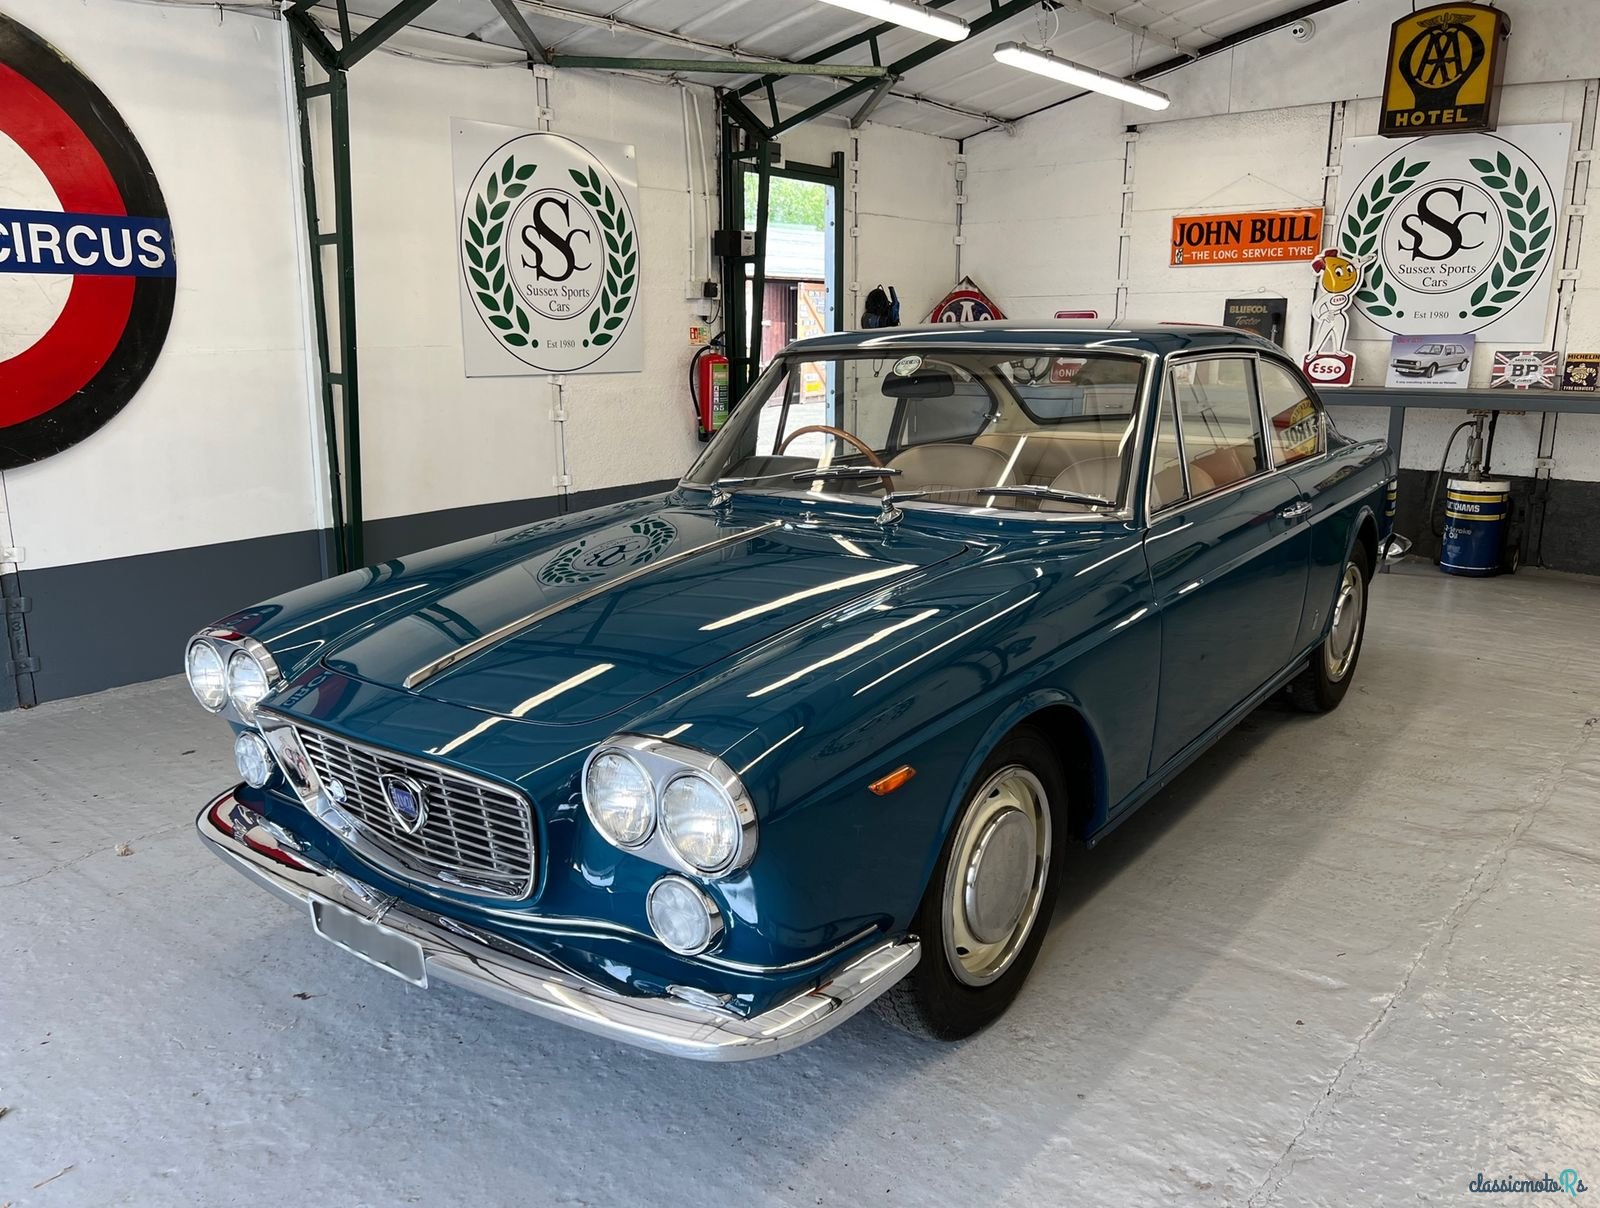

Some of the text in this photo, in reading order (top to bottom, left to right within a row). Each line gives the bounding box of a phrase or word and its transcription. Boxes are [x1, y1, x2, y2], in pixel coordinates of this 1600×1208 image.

[1395, 108, 1468, 127] HOTEL
[1173, 216, 1319, 247] JOHN BULL
[1213, 249, 1238, 260] LONG
[1242, 247, 1284, 259] SERVICE
[1287, 245, 1314, 257] TYRE
[1398, 263, 1477, 277] Sussex Sports
[1422, 277, 1448, 287] Cars
[526, 283, 590, 301] Sussex Sports
[548, 299, 571, 312] Cars
[1229, 305, 1269, 314] BLUECOL
[1413, 311, 1449, 319] Est 1980
[546, 340, 576, 349] Est 1980
[1567, 353, 1600, 361] MICHELIN
[1510, 364, 1539, 377] BP
